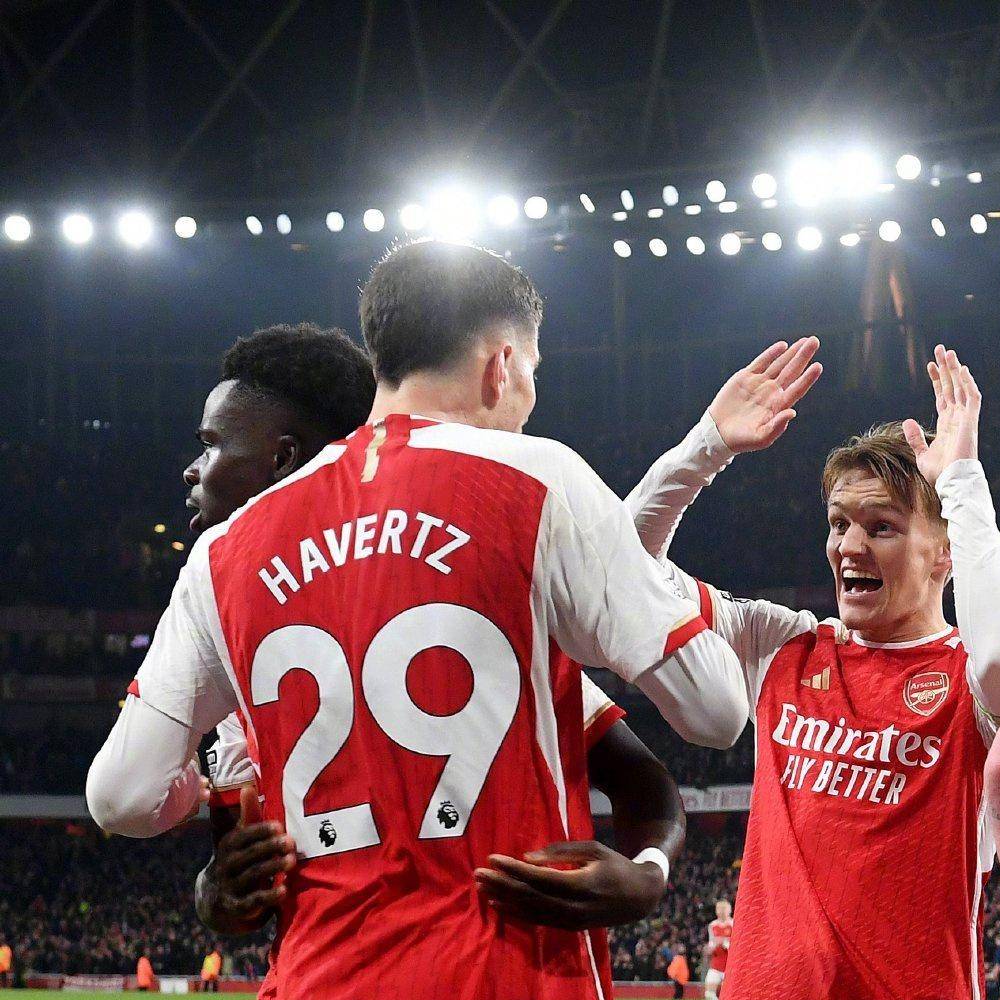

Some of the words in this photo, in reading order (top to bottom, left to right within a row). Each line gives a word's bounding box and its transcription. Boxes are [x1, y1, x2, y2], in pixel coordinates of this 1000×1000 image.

[258, 509, 471, 605] HAVERTZ
[910, 679, 943, 691] Arsenal
[250, 602, 521, 859] 29
[772, 702, 942, 768] Emirates
[780, 754, 816, 790] FLY
[811, 760, 907, 804] BETTER
